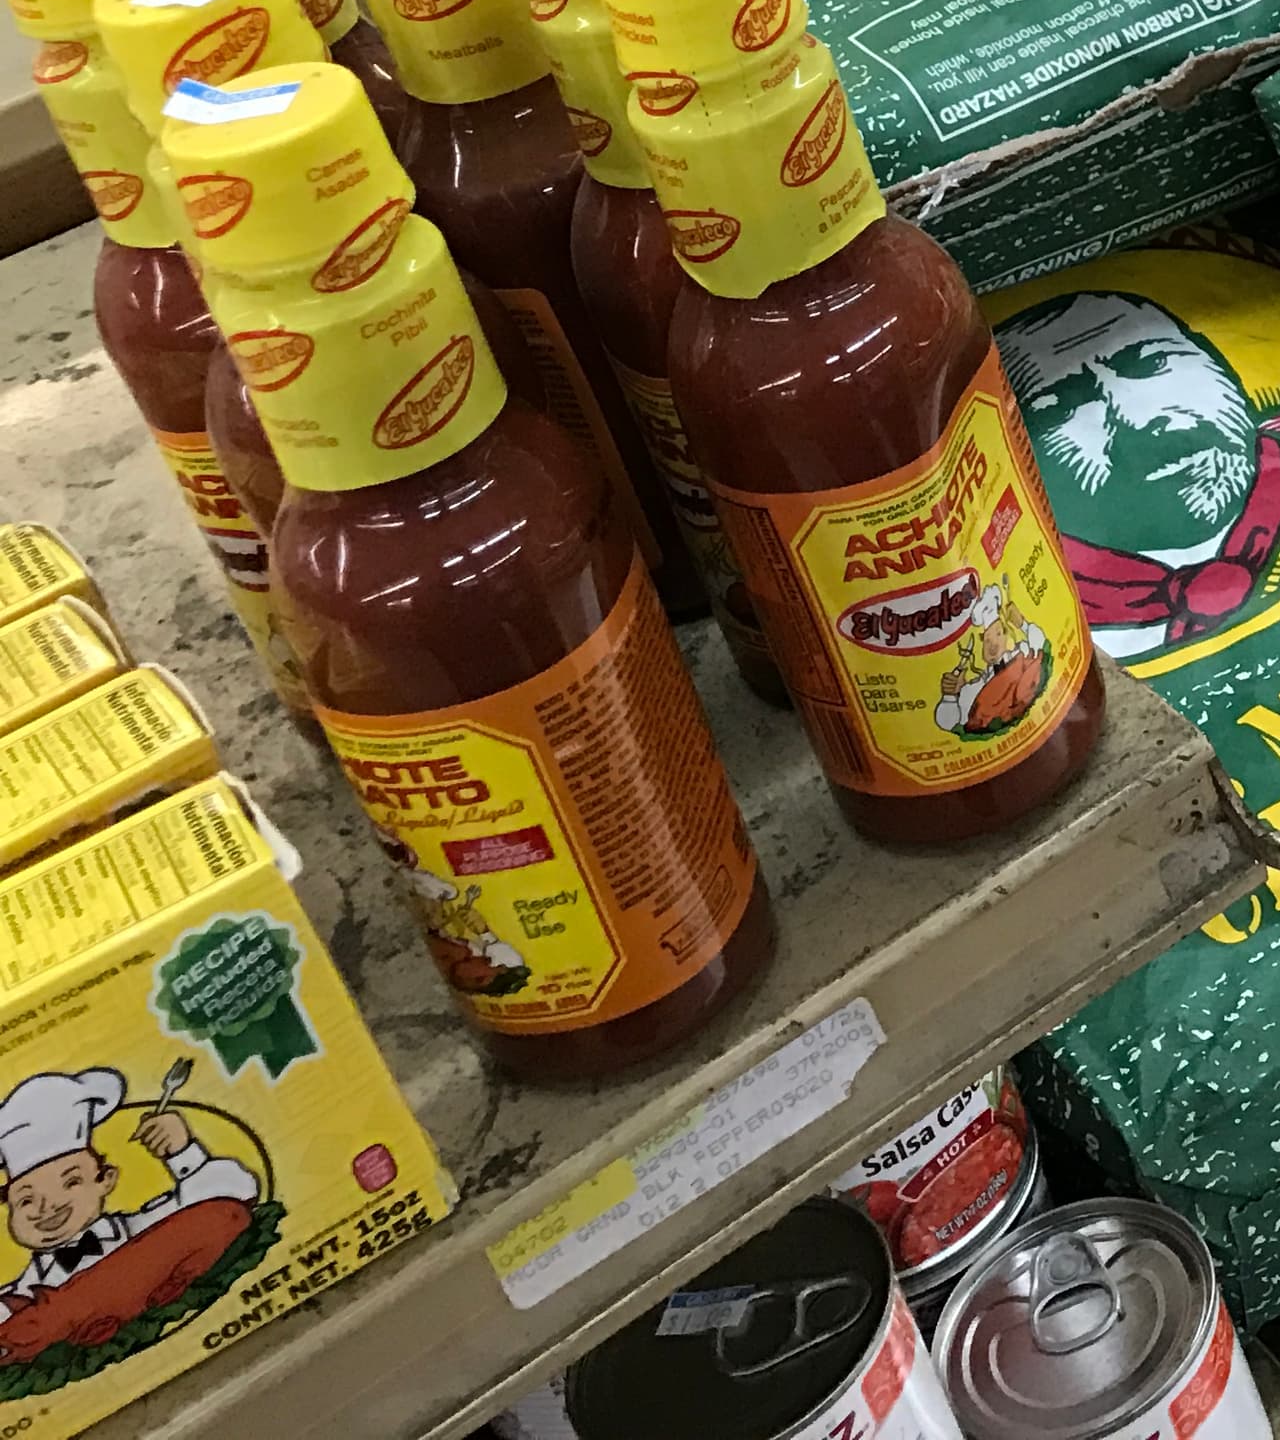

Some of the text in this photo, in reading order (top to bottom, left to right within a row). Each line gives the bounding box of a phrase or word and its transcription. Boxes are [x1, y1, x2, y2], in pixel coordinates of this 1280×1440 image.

[1061, 1, 1128, 41] charcoal
[985, 49, 1018, 73] can
[1015, 28, 1066, 61] inside
[1017, 29, 1123, 90] MONOXIDE
[923, 50, 970, 81] which
[925, 69, 964, 98] you.
[962, 63, 988, 85] kill
[935, 75, 1022, 127] HAZARD
[1115, 208, 1185, 244] CARBON
[360, 286, 438, 340] Cochinita
[392, 316, 430, 348] Pibil
[845, 434, 977, 557] ACHIOTE
[844, 452, 988, 583] ANNATTO
[1018, 540, 1044, 584] Ready
[1032, 577, 1049, 606] Use
[854, 673, 897, 686] Listo
[861, 687, 899, 700] para
[105, 689, 160, 756] Nutrimental
[865, 697, 926, 712] Usarse
[180, 800, 228, 879] Nutrimental
[513, 890, 578, 912] Ready
[519, 911, 547, 924] for
[522, 922, 566, 939] Use
[172, 918, 267, 996] RECIPE
[180, 938, 273, 1013] Included
[203, 959, 278, 1018] Receta
[861, 1125, 936, 1178] Salsa
[936, 1134, 968, 1168] HOT
[239, 1191, 423, 1306] NET WT. 15oz
[935, 1221, 954, 1240] NET
[202, 1207, 434, 1353] CONT. NET. 425g
